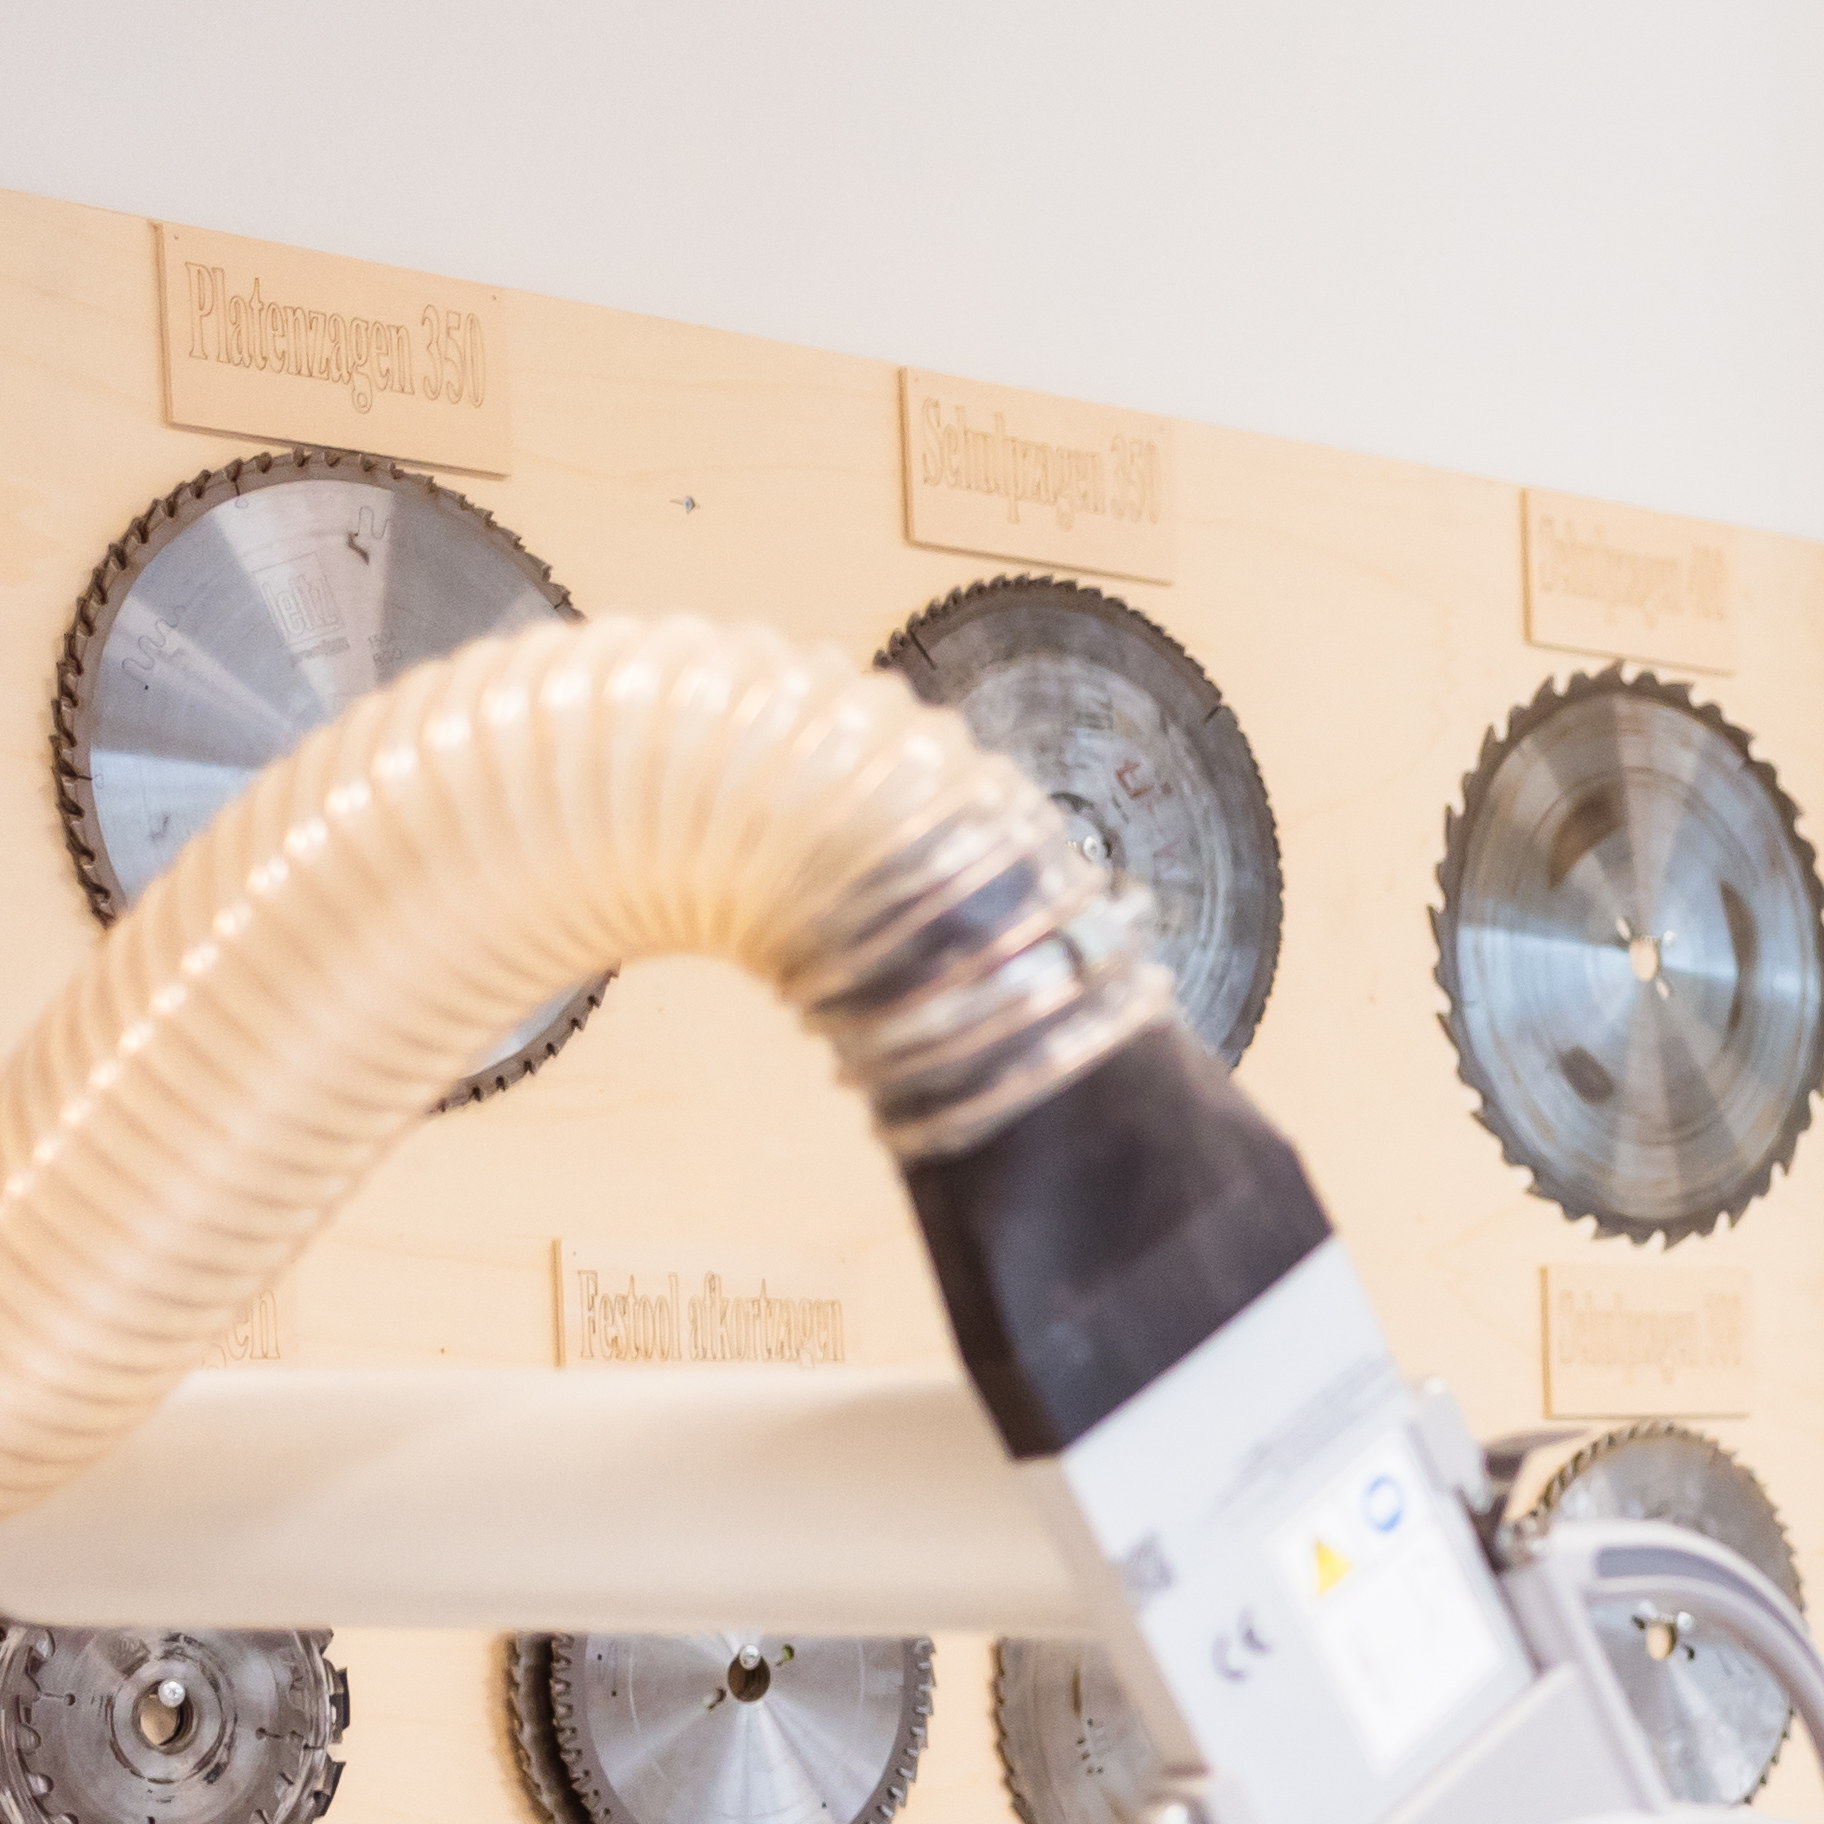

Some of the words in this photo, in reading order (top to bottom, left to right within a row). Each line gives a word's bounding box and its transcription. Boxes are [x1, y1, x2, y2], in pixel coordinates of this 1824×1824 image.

[185, 261, 415, 414] Platenzagen
[420, 304, 487, 408] 350
[921, 396, 1106, 531] Schulpzagen
[1109, 433, 1162, 525] 350
[577, 1269, 682, 1362] Festool
